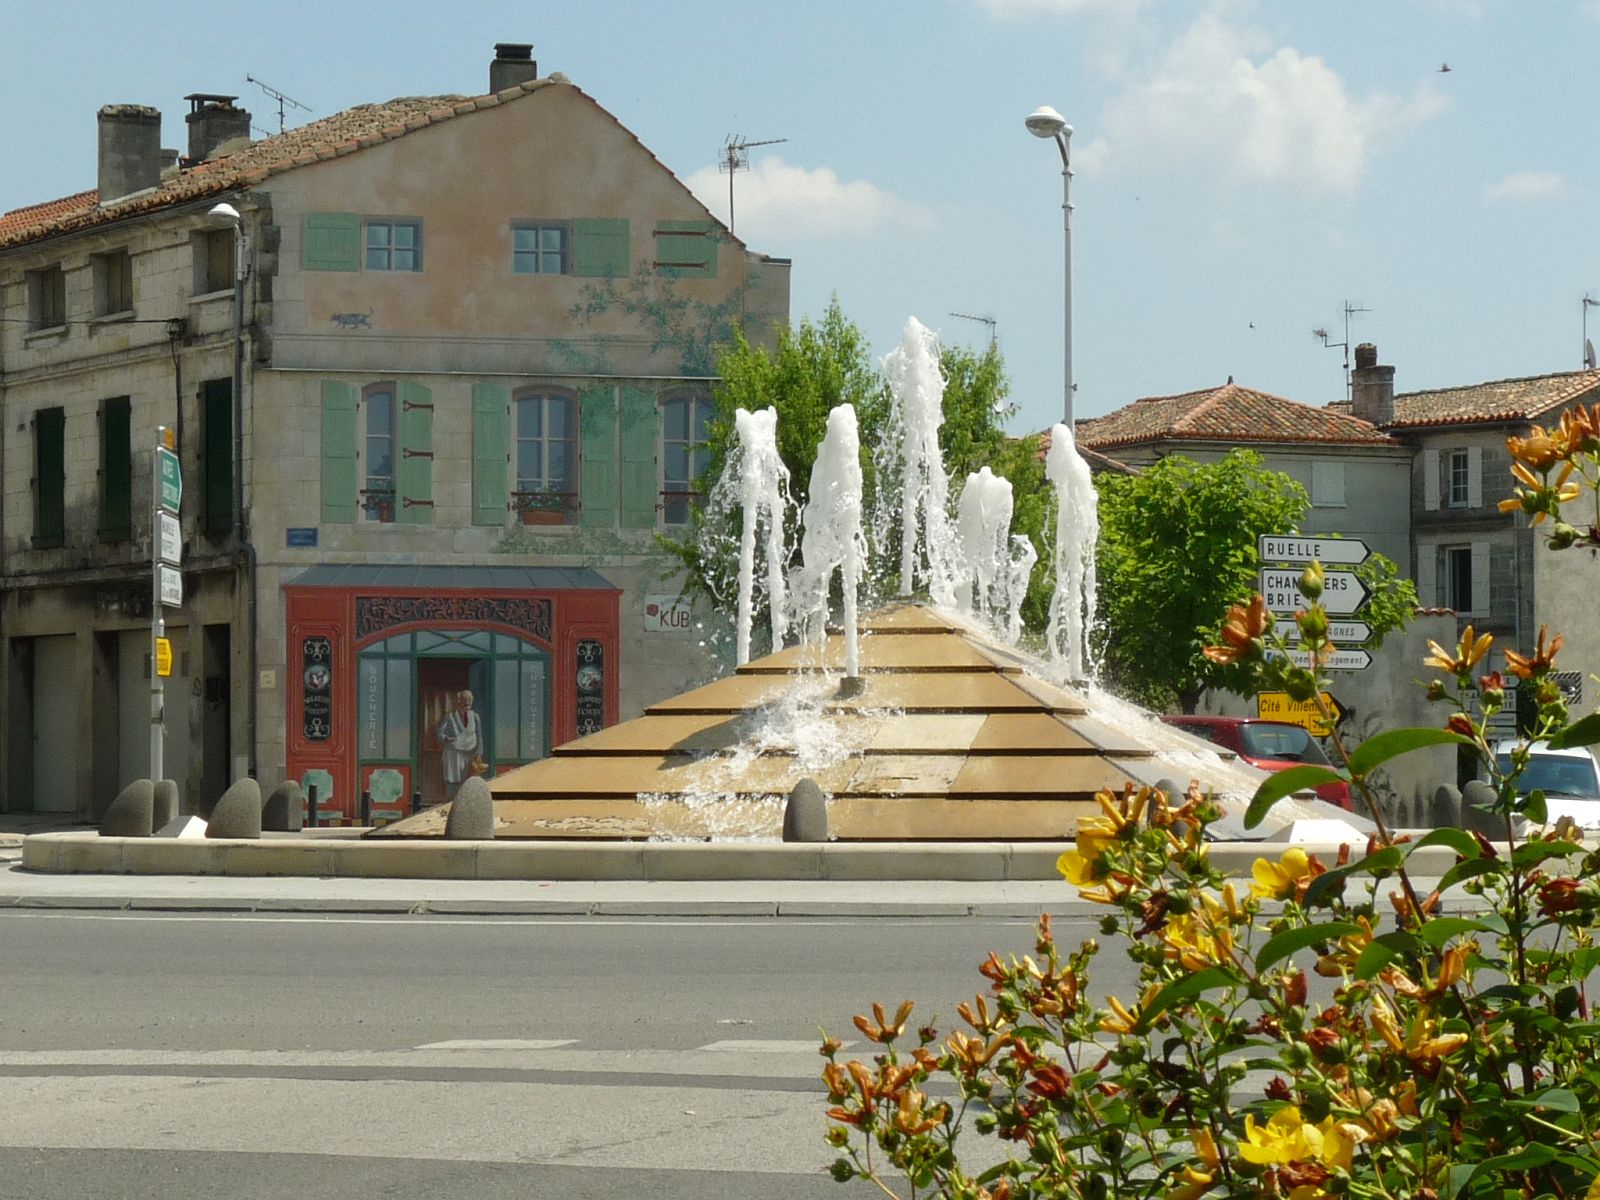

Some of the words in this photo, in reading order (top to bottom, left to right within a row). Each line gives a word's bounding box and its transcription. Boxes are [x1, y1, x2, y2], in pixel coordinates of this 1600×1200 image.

[1267, 543, 1321, 557] RUELLE
[1267, 593, 1301, 606] BRIE
[660, 610, 690, 628] KUB
[368, 665, 378, 749] BOUCHERIE
[1260, 700, 1281, 712] Cité
